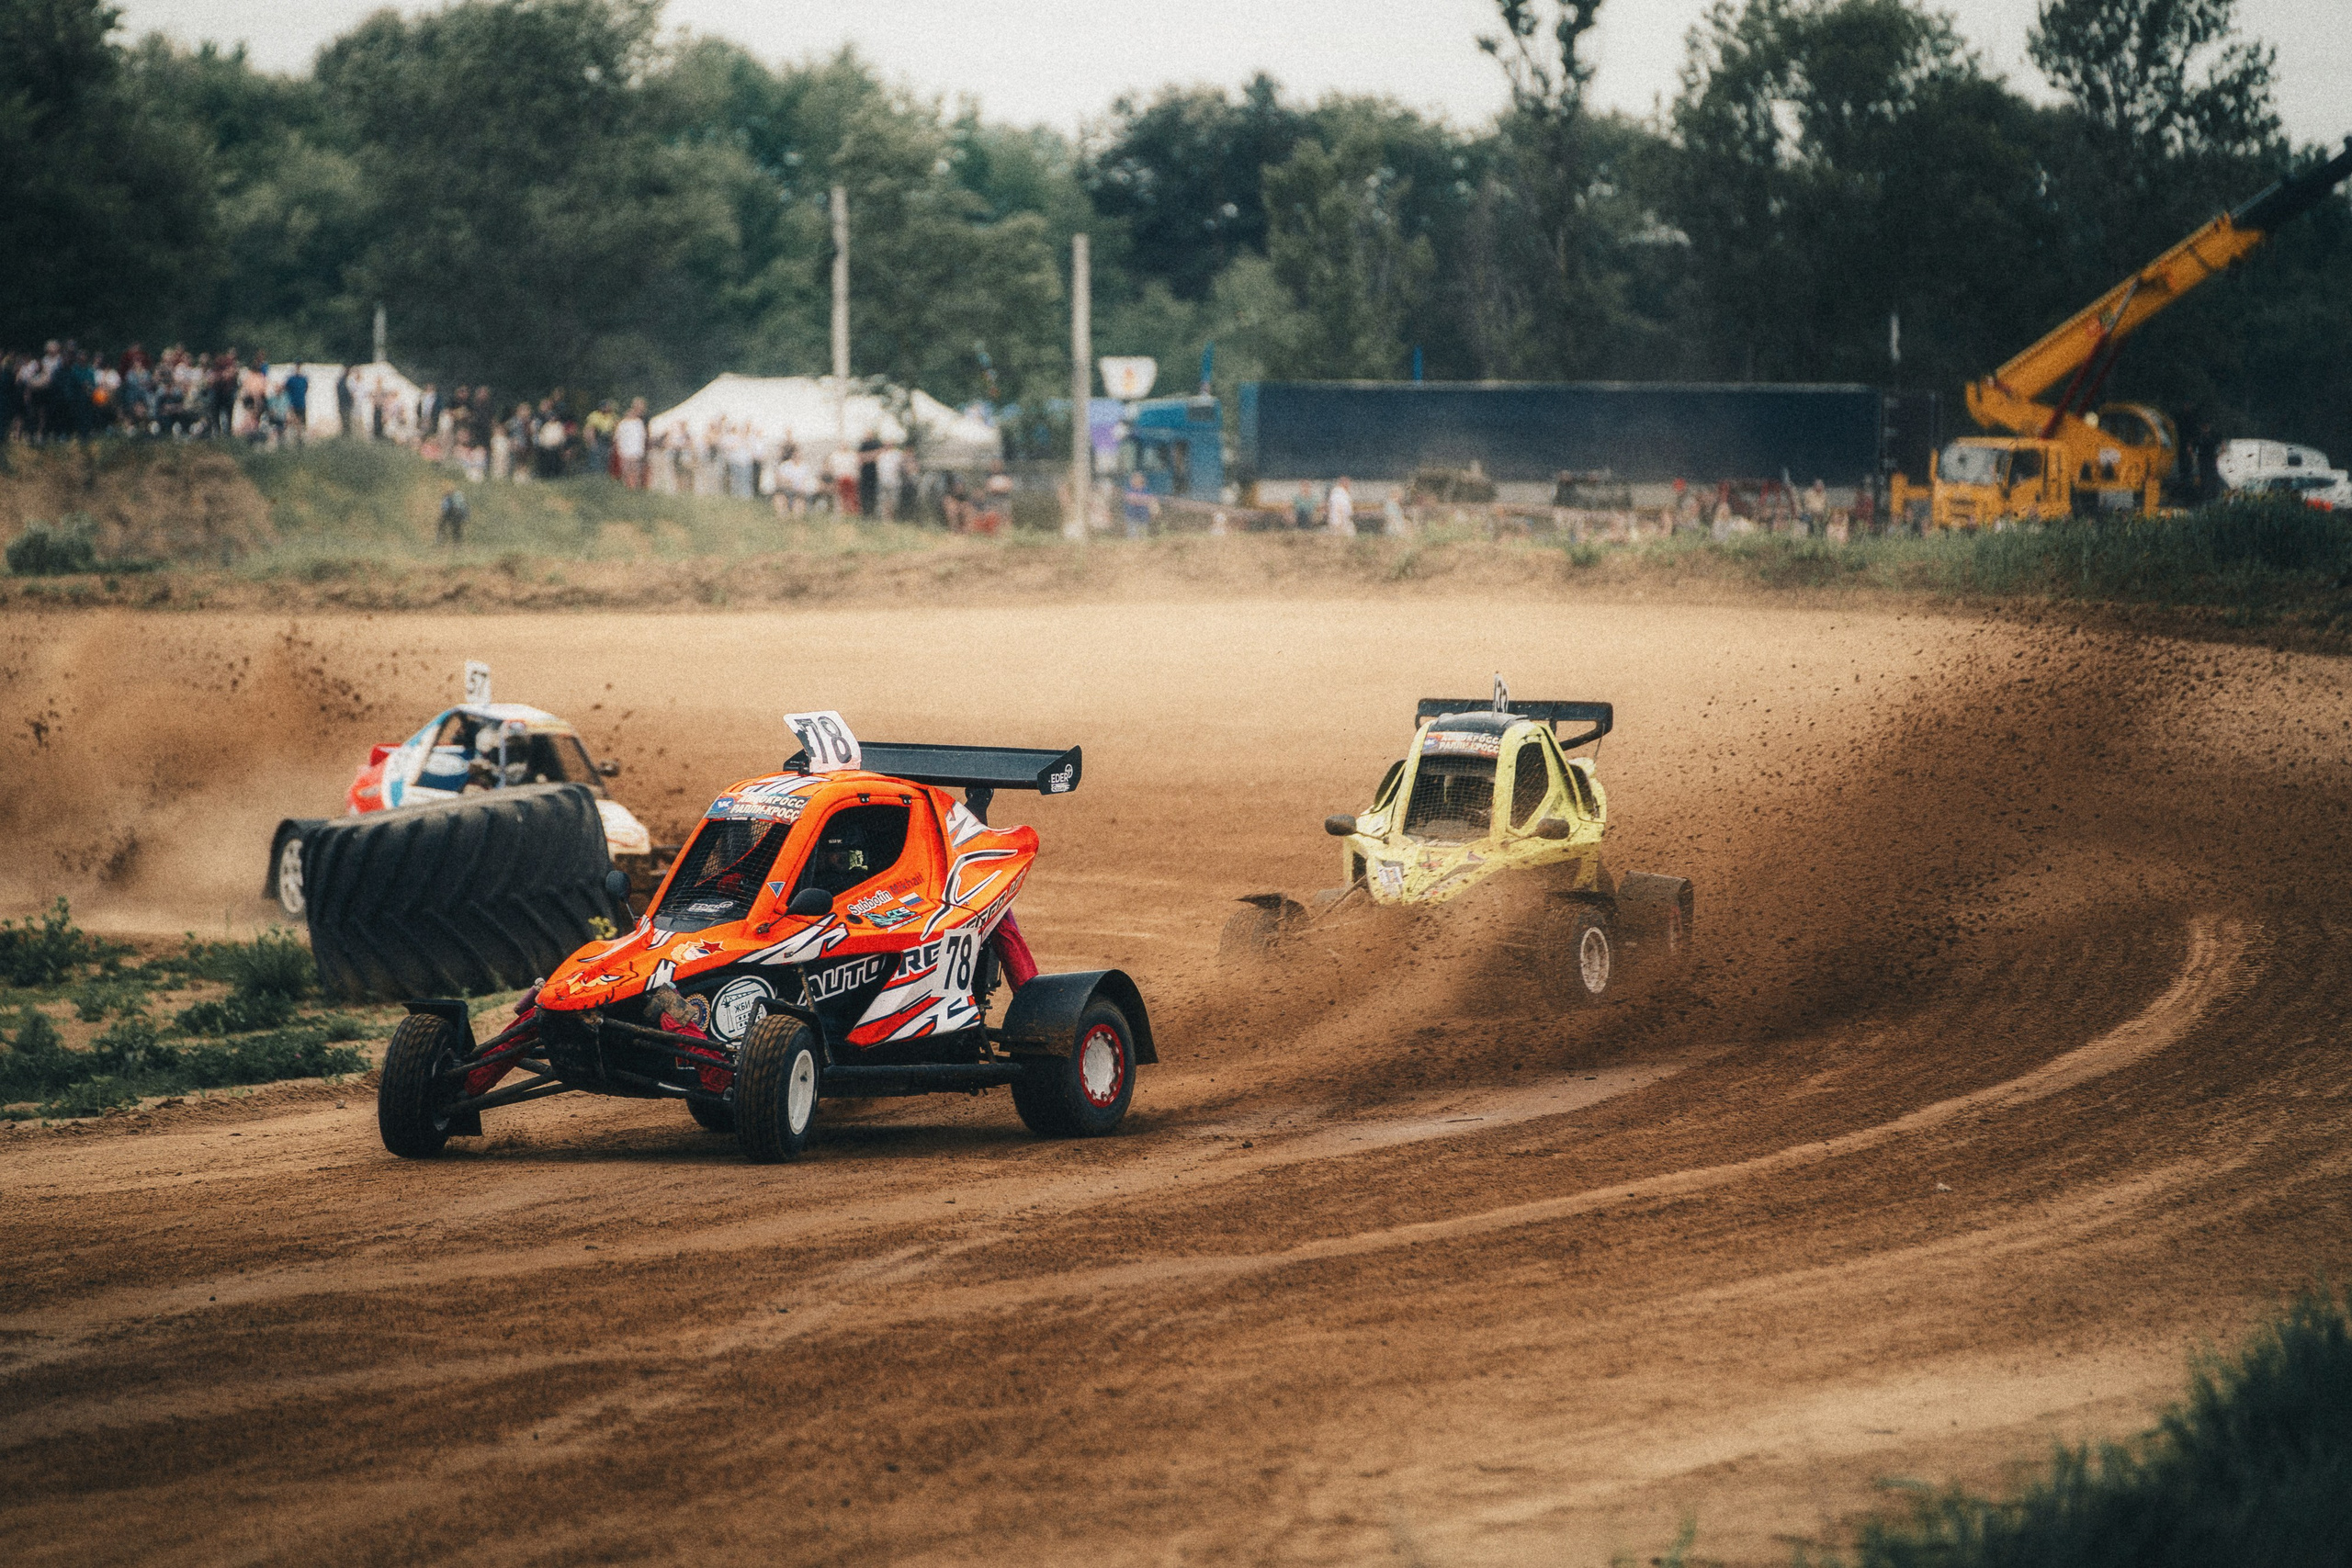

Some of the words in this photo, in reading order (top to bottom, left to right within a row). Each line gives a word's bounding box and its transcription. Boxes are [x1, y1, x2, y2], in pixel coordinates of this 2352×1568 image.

[794, 716, 853, 763] 78
[1050, 773, 1069, 784] EDER
[848, 890, 893, 915] Subbotin
[889, 872, 924, 895] Mikhail
[944, 933, 972, 991] 78
